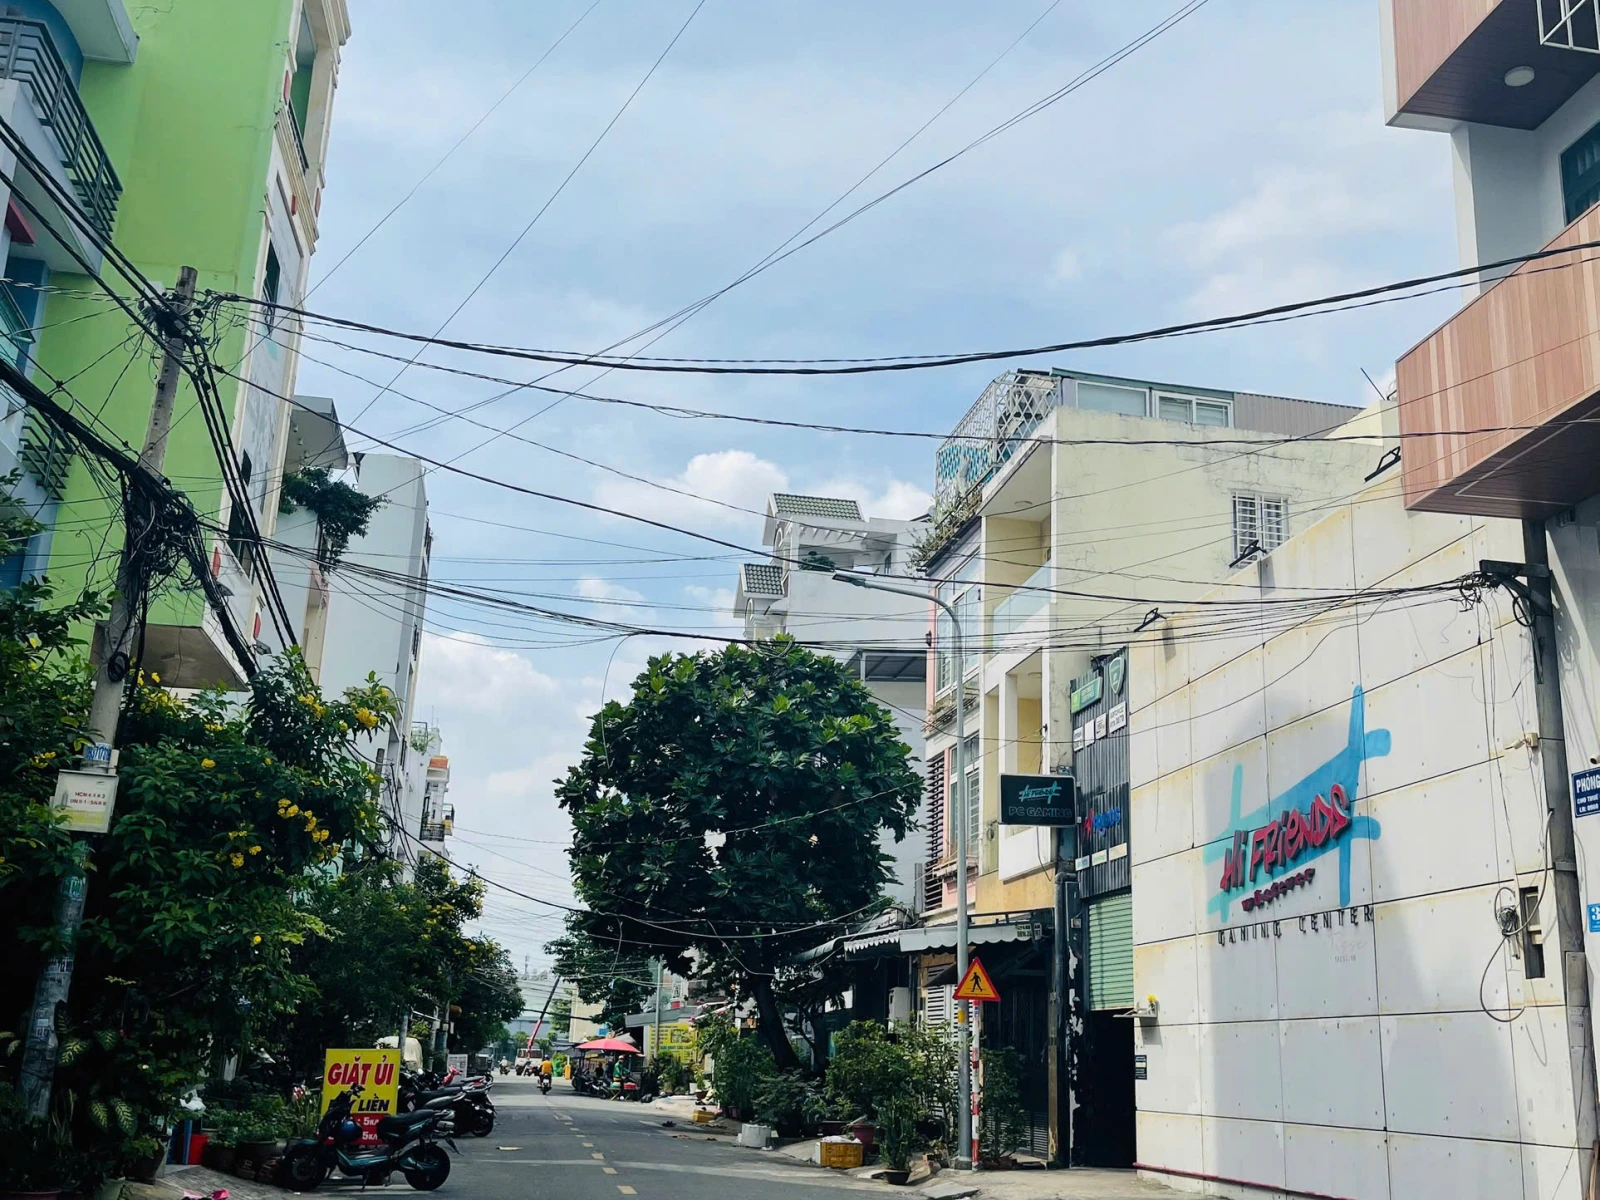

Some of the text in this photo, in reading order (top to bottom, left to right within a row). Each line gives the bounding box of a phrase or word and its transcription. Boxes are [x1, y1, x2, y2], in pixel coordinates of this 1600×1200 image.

[1008, 806, 1072, 818] PC GAMING
[1217, 905, 1374, 947] GAMING CENTER
[374, 1054, 395, 1085] ỦI
[358, 1093, 390, 1112] LIỀN
